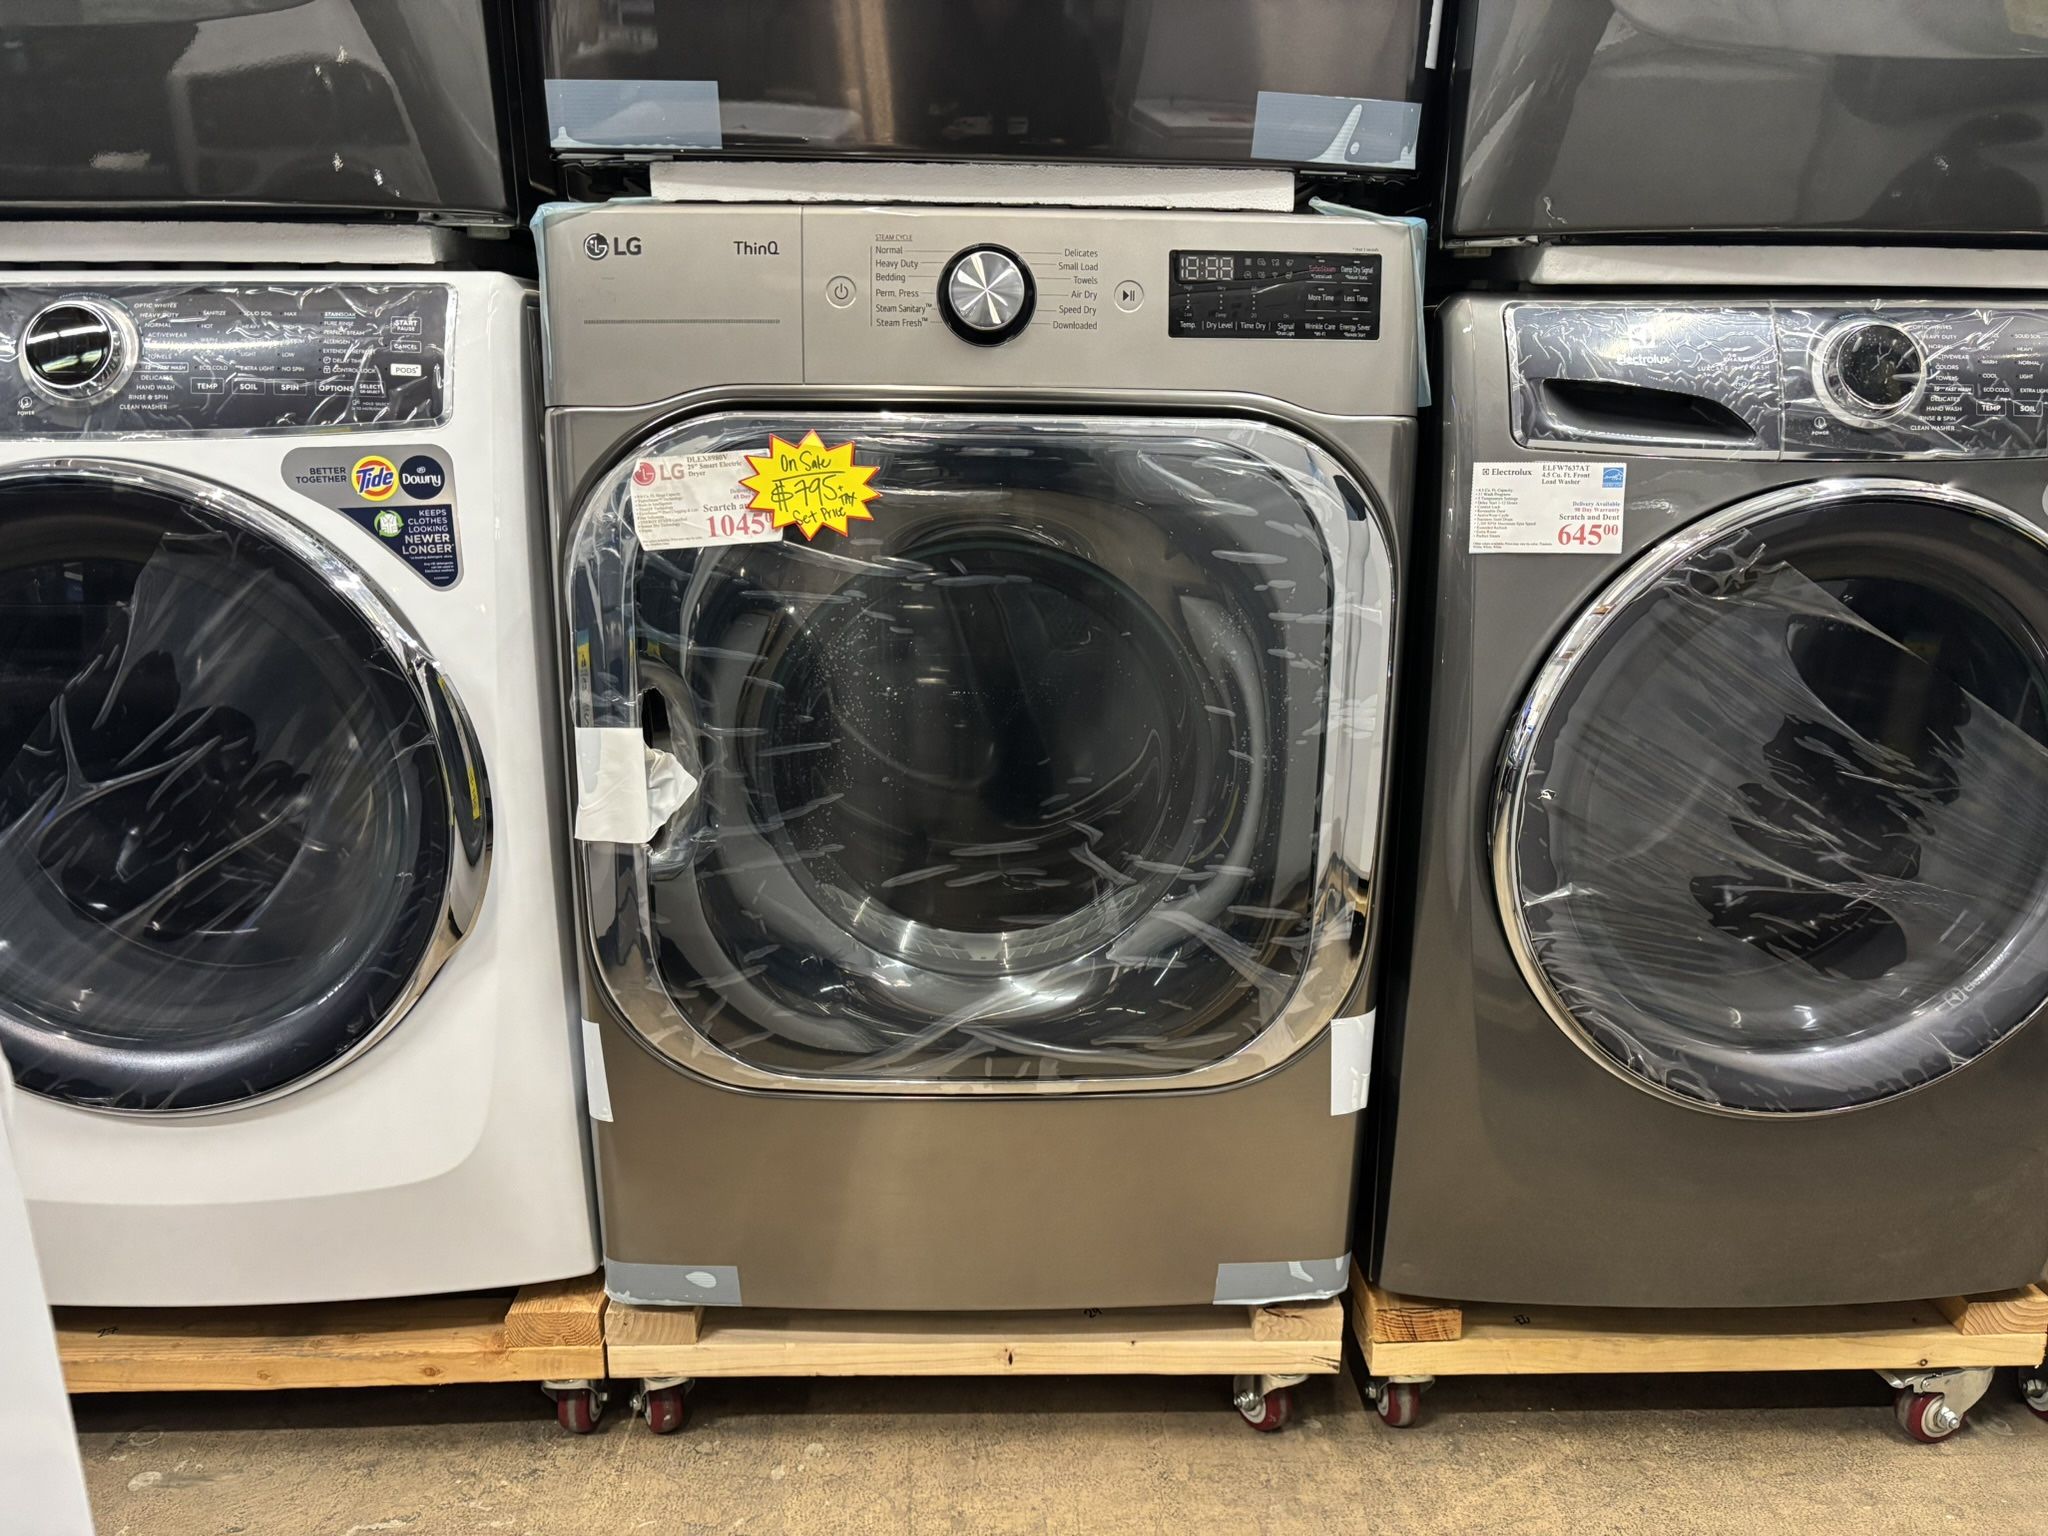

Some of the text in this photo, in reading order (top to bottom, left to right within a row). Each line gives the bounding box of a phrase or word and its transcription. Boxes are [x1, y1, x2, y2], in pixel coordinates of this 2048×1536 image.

[613, 236, 642, 256] LG
[733, 241, 780, 255] ThinQ
[875, 246, 903, 254] Normal
[1064, 248, 1098, 257] Delicates
[875, 259, 919, 269] Heavy Duty
[1058, 262, 1098, 271] Small Load
[875, 272, 906, 283] Bedding
[1073, 276, 1098, 284] Towels
[875, 289, 919, 297] Perm. Press
[1071, 290, 1098, 301] Air Dry
[1322, 294, 1334, 302] Time
[875, 304, 897, 313] Steam
[1059, 305, 1097, 316] Speed Dry
[876, 319, 900, 327] Steam
[1053, 321, 1098, 330] Downloaded
[1206, 321, 1233, 331] Dry Level
[1255, 322, 1266, 331] Dry
[1277, 323, 1295, 331] Signal
[1616, 355, 1671, 365] Electrolux
[239, 383, 258, 391] SOIL
[318, 384, 354, 392] OPTIONS
[781, 450, 832, 472] On Sale
[309, 467, 346, 475] BETTER
[660, 463, 685, 481] LG
[1491, 468, 1532, 476] Electrolux
[296, 475, 347, 484] TOGETHER
[356, 466, 394, 494] Tide
[402, 473, 442, 487] Downy
[770, 474, 838, 512] $795
[703, 503, 737, 513] Scartch
[418, 509, 447, 517] KEEPS
[793, 507, 846, 526] Set Price
[407, 517, 448, 525] CLOTHES
[408, 525, 449, 533] LOOKING
[404, 534, 450, 544] NEWER
[402, 544, 454, 555] LONGER
